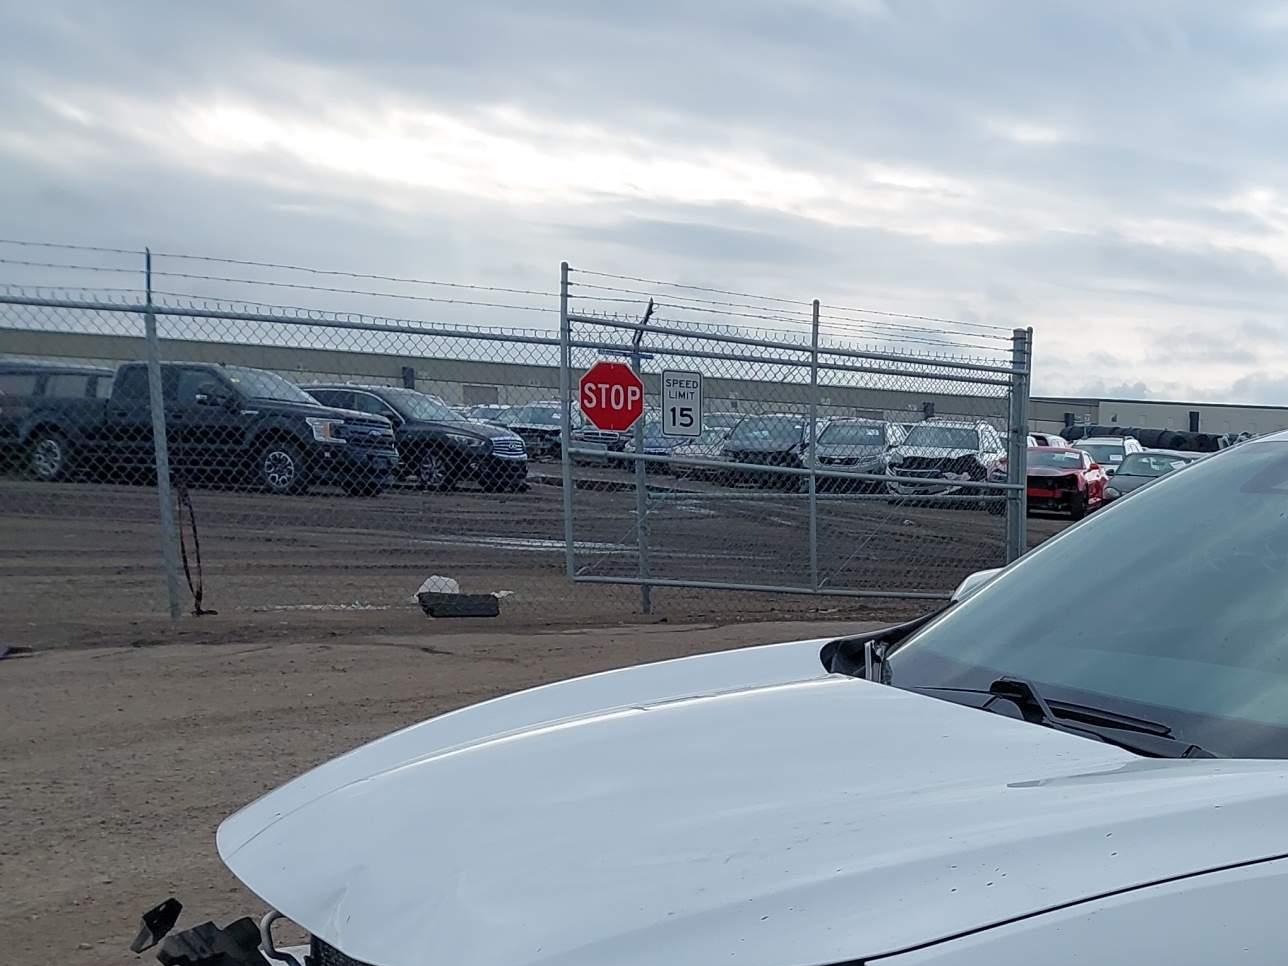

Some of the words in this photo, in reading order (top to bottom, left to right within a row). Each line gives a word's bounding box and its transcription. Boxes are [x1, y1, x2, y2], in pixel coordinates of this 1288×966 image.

[665, 378, 698, 388] SPEED
[583, 383, 641, 410] STOP
[668, 391, 695, 400] LIMIT
[669, 406, 694, 428] 15
